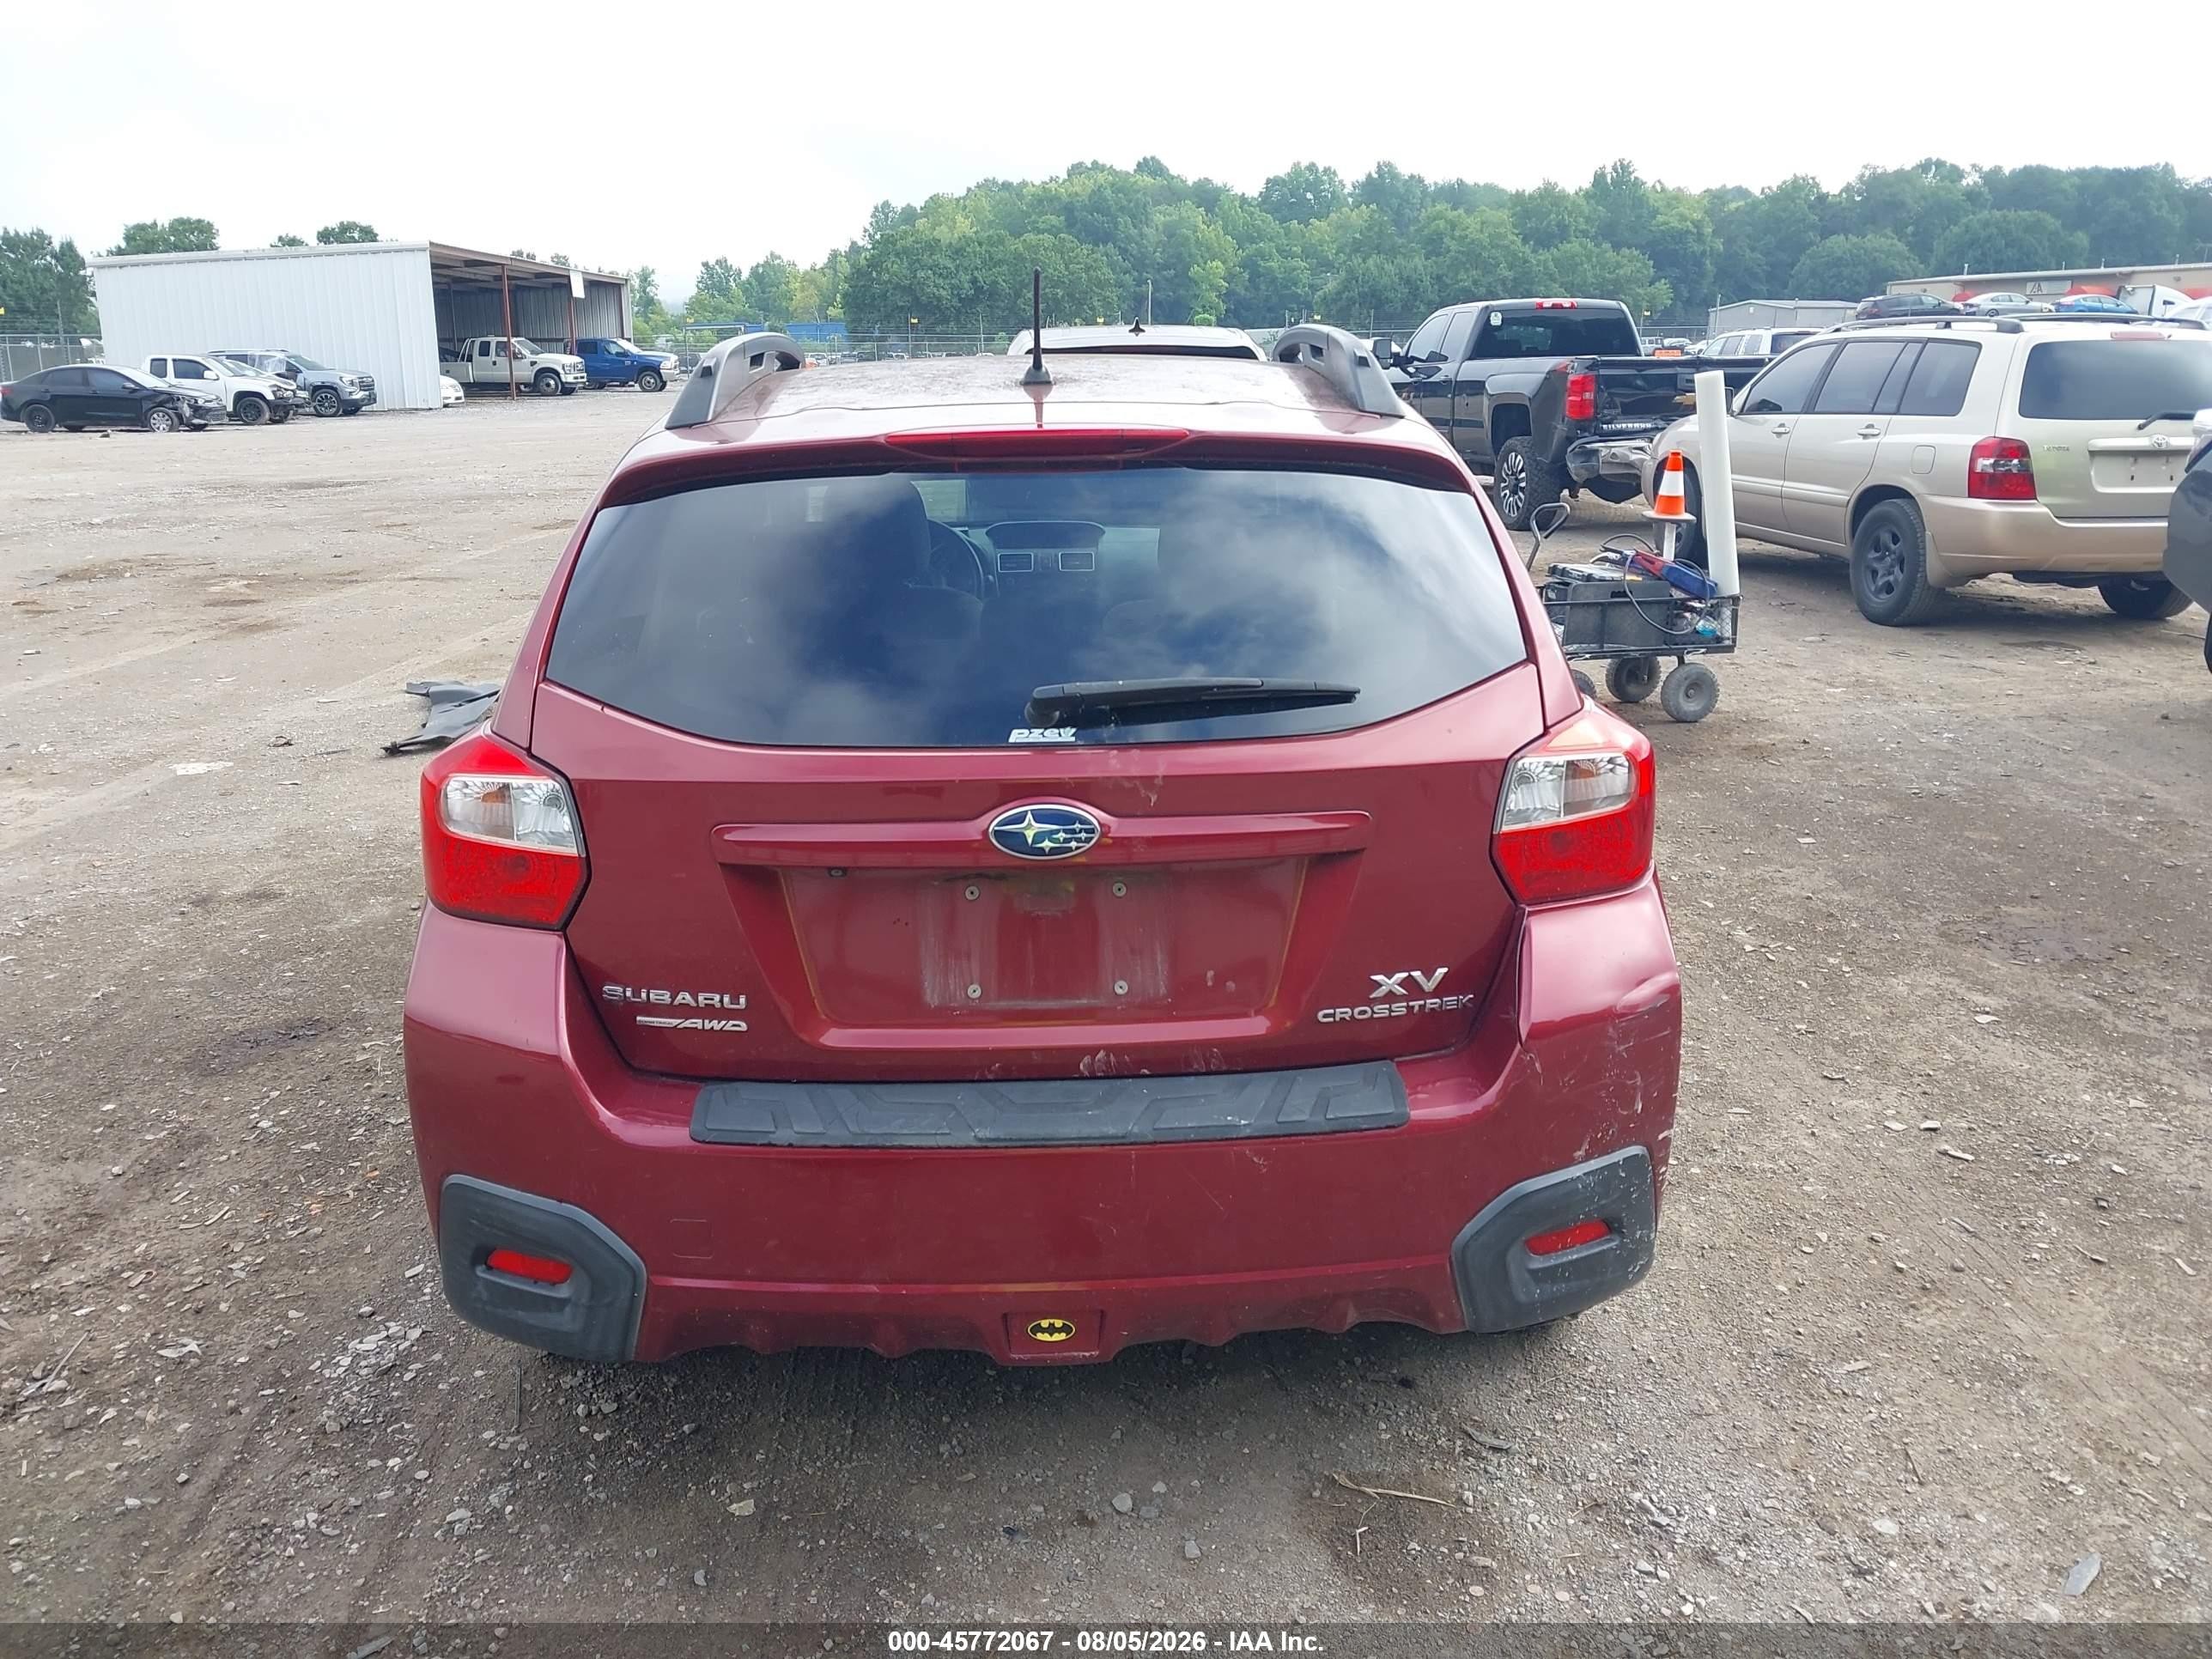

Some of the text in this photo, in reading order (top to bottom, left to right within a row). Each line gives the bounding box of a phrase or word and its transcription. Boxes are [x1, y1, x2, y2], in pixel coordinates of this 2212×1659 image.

[1369, 967, 1449, 999] XV
[602, 985, 747, 1010] SUBARU
[1316, 994, 1474, 1024] CROSSTREK
[676, 1018, 748, 1031] AWD
